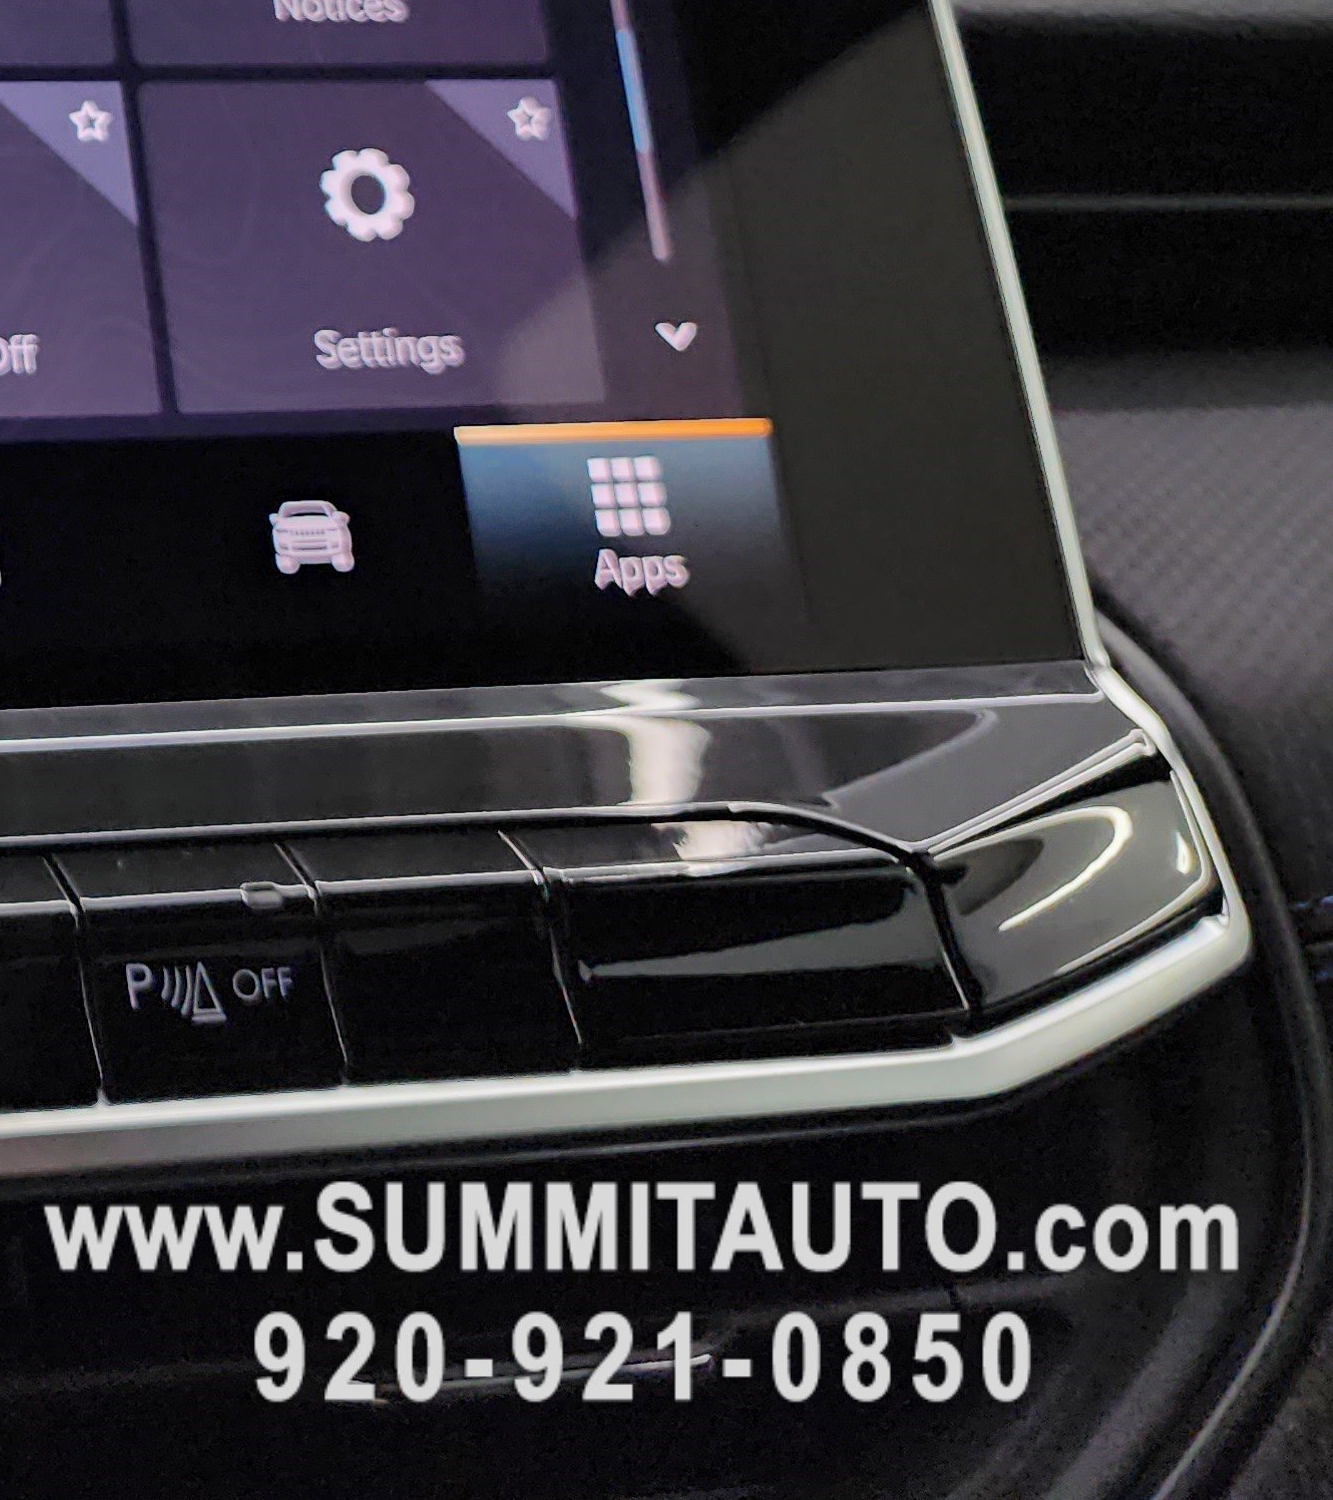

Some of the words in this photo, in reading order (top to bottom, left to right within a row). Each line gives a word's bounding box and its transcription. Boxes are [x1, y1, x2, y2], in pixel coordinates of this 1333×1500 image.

[313, 327, 465, 374] Settings
[594, 548, 690, 596] Apps
[125, 963, 153, 1009] P
[232, 966, 293, 1001] OFF
